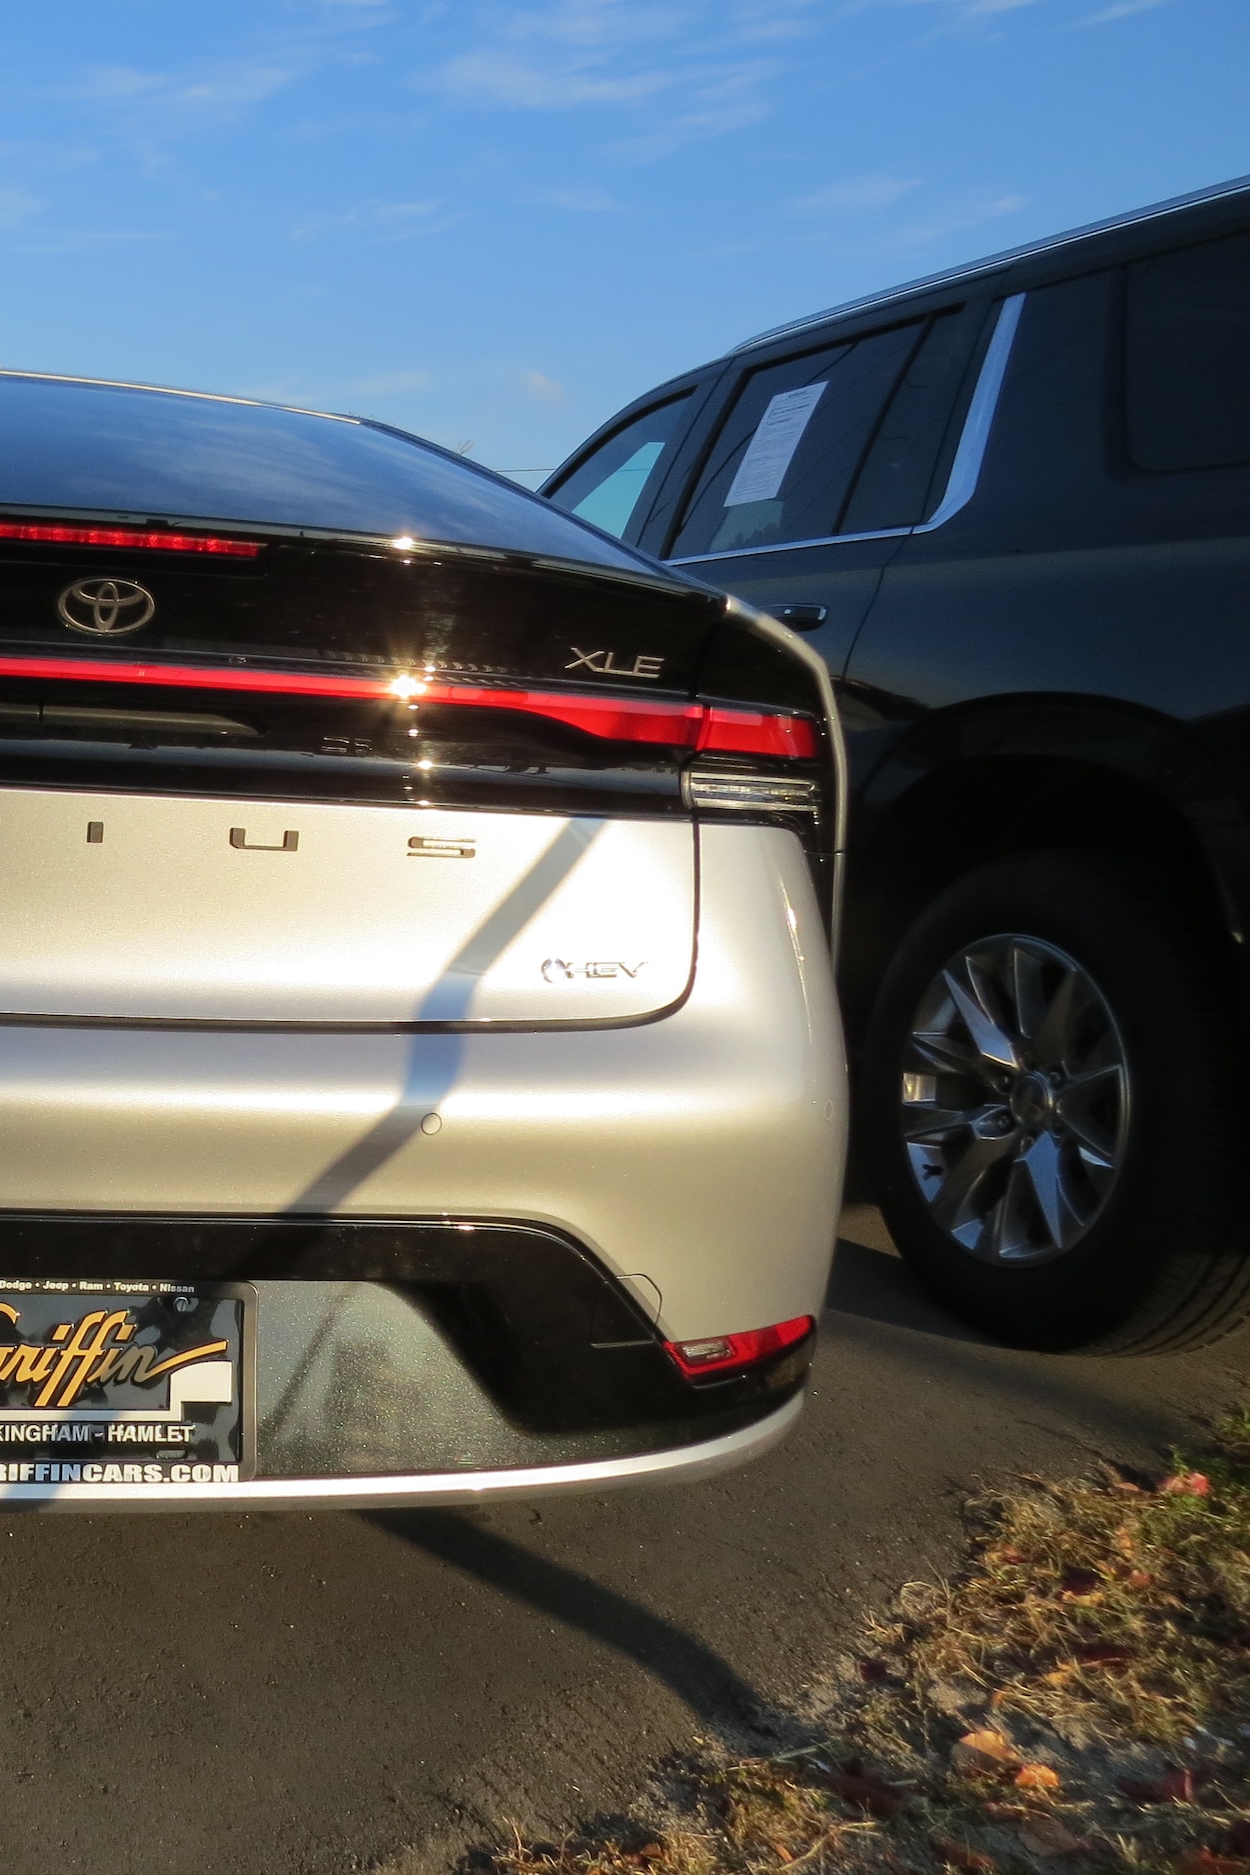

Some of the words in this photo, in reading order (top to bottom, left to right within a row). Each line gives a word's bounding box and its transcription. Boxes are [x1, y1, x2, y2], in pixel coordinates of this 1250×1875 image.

[564, 647, 665, 678] XLE
[42, 1280, 69, 1291] Jeep
[79, 1281, 103, 1291] Ram
[113, 1281, 149, 1293] Toyota
[159, 1282, 195, 1293] Nissan
[107, 1424, 196, 1444] HAMLET
